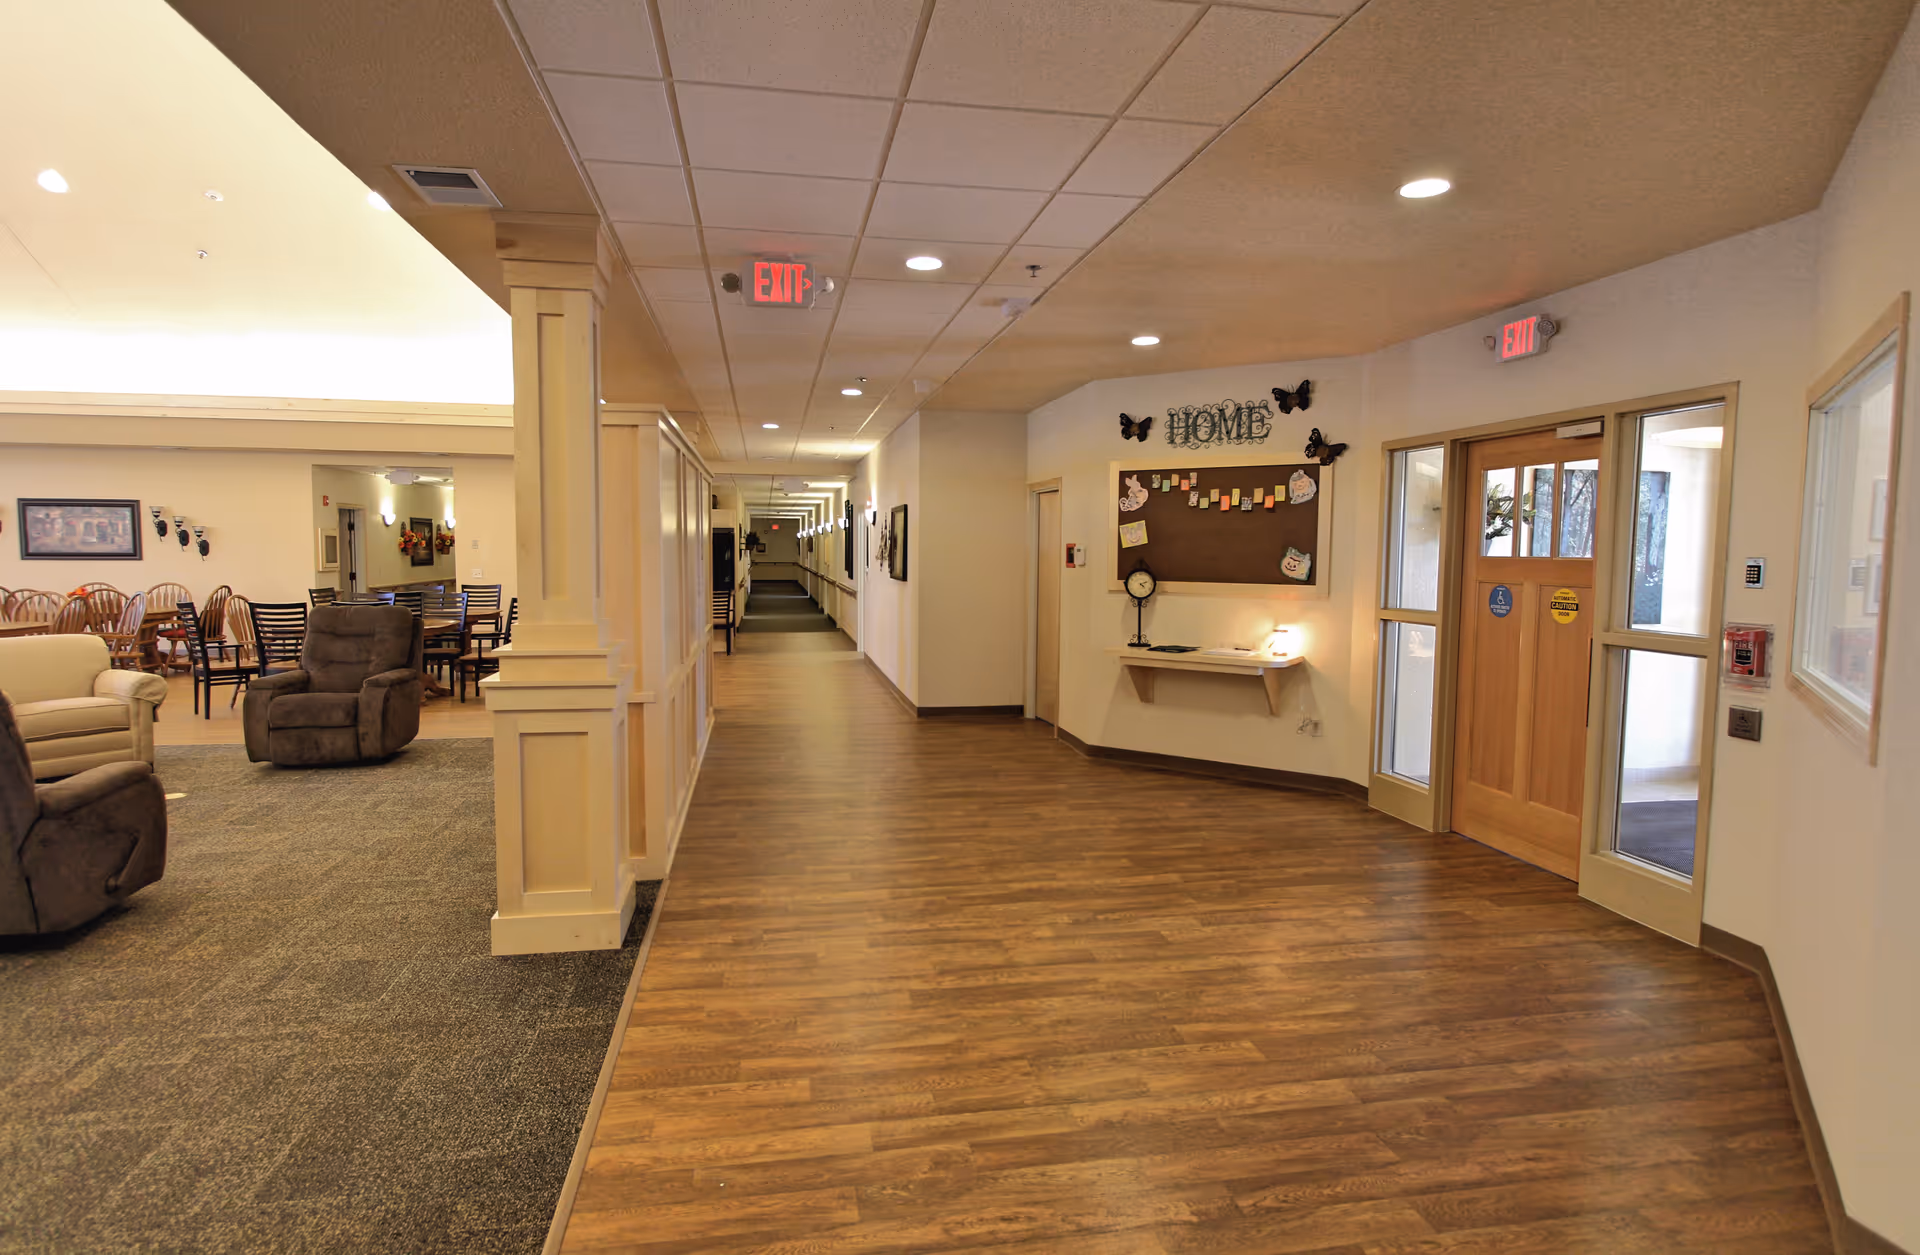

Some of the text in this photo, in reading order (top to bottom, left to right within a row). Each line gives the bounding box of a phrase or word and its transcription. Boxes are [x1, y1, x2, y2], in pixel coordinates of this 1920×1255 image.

[754, 262, 806, 303] EXIT
[1502, 316, 1536, 358] EXIT
[1164, 399, 1274, 450] HOME
[1551, 602, 1577, 610] CAUTION
[1735, 641, 1753, 649] FIRE
